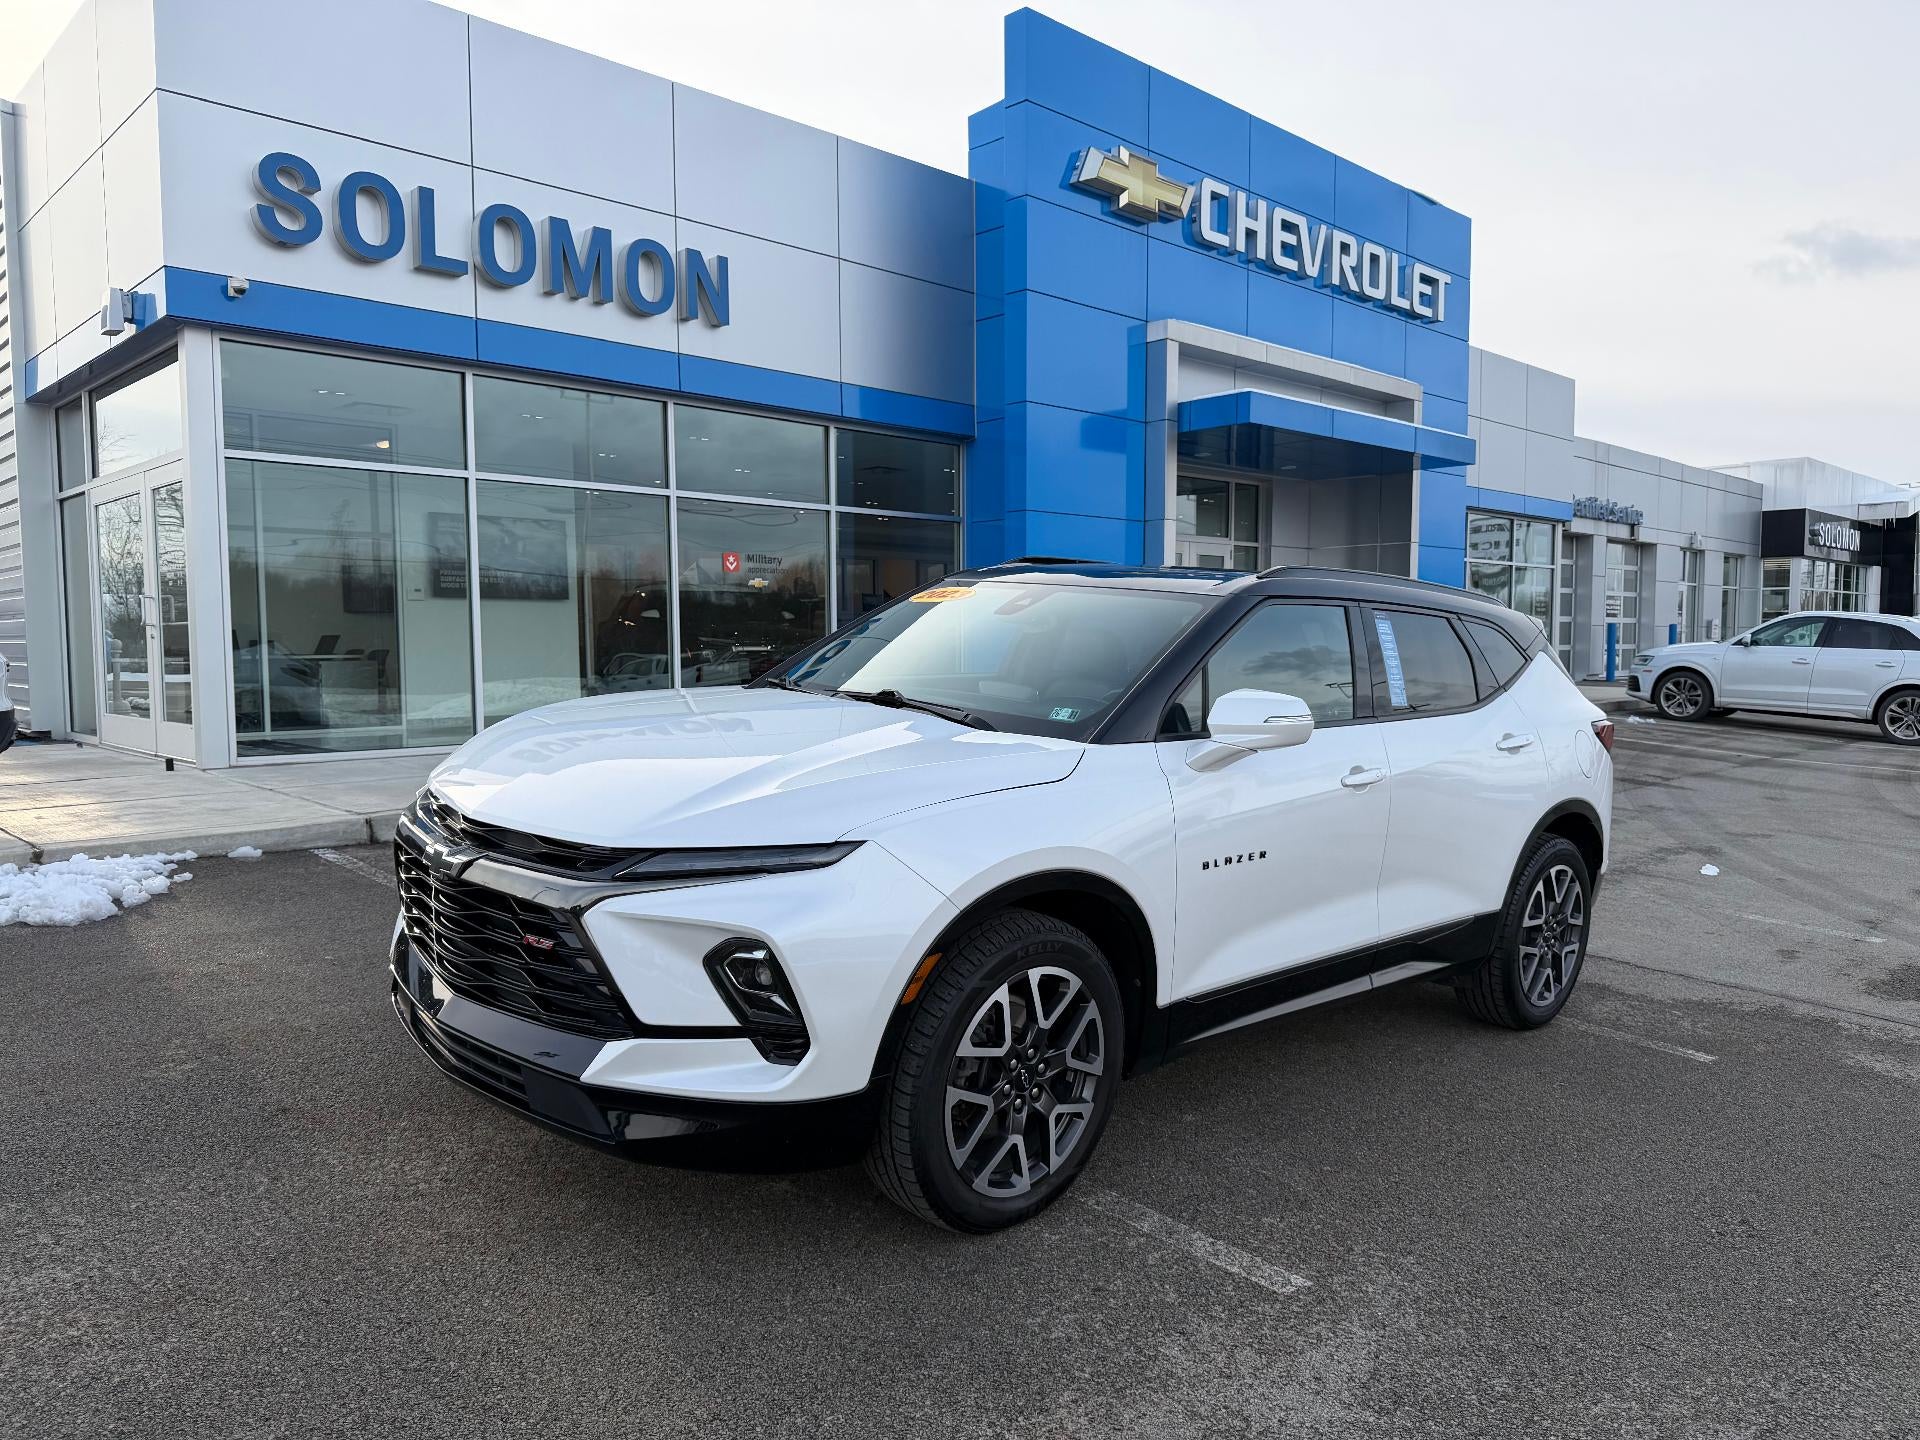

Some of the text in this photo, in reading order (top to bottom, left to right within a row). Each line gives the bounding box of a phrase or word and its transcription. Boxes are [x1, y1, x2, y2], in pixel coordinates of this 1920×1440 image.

[250, 151, 730, 328] SOLOMON
[1199, 176, 1452, 323] CHEVROLET
[1819, 521, 1860, 551] SOLOMON
[746, 553, 783, 566] Military
[1202, 850, 1267, 871] BLAZER
[524, 935, 554, 949] RS
[1017, 941, 1065, 961] KELLY
